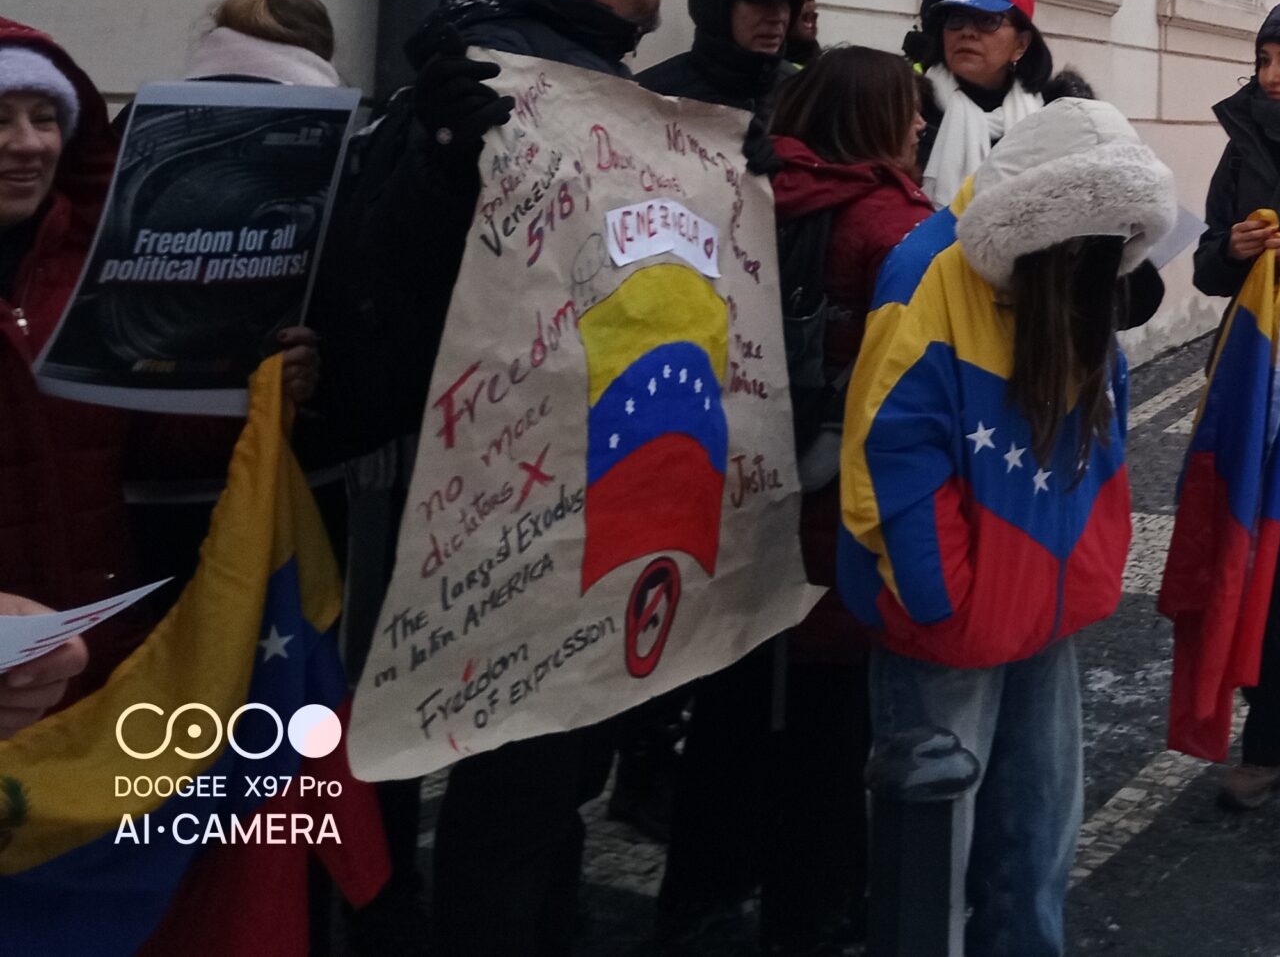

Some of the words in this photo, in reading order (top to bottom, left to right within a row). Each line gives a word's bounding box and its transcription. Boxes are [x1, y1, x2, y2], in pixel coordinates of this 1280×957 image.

[133, 228, 235, 255] Freedom
[237, 226, 269, 253] for
[270, 223, 298, 250] all
[98, 255, 203, 284] political
[203, 250, 309, 284] prisoners!
[432, 299, 579, 450] Freedom
